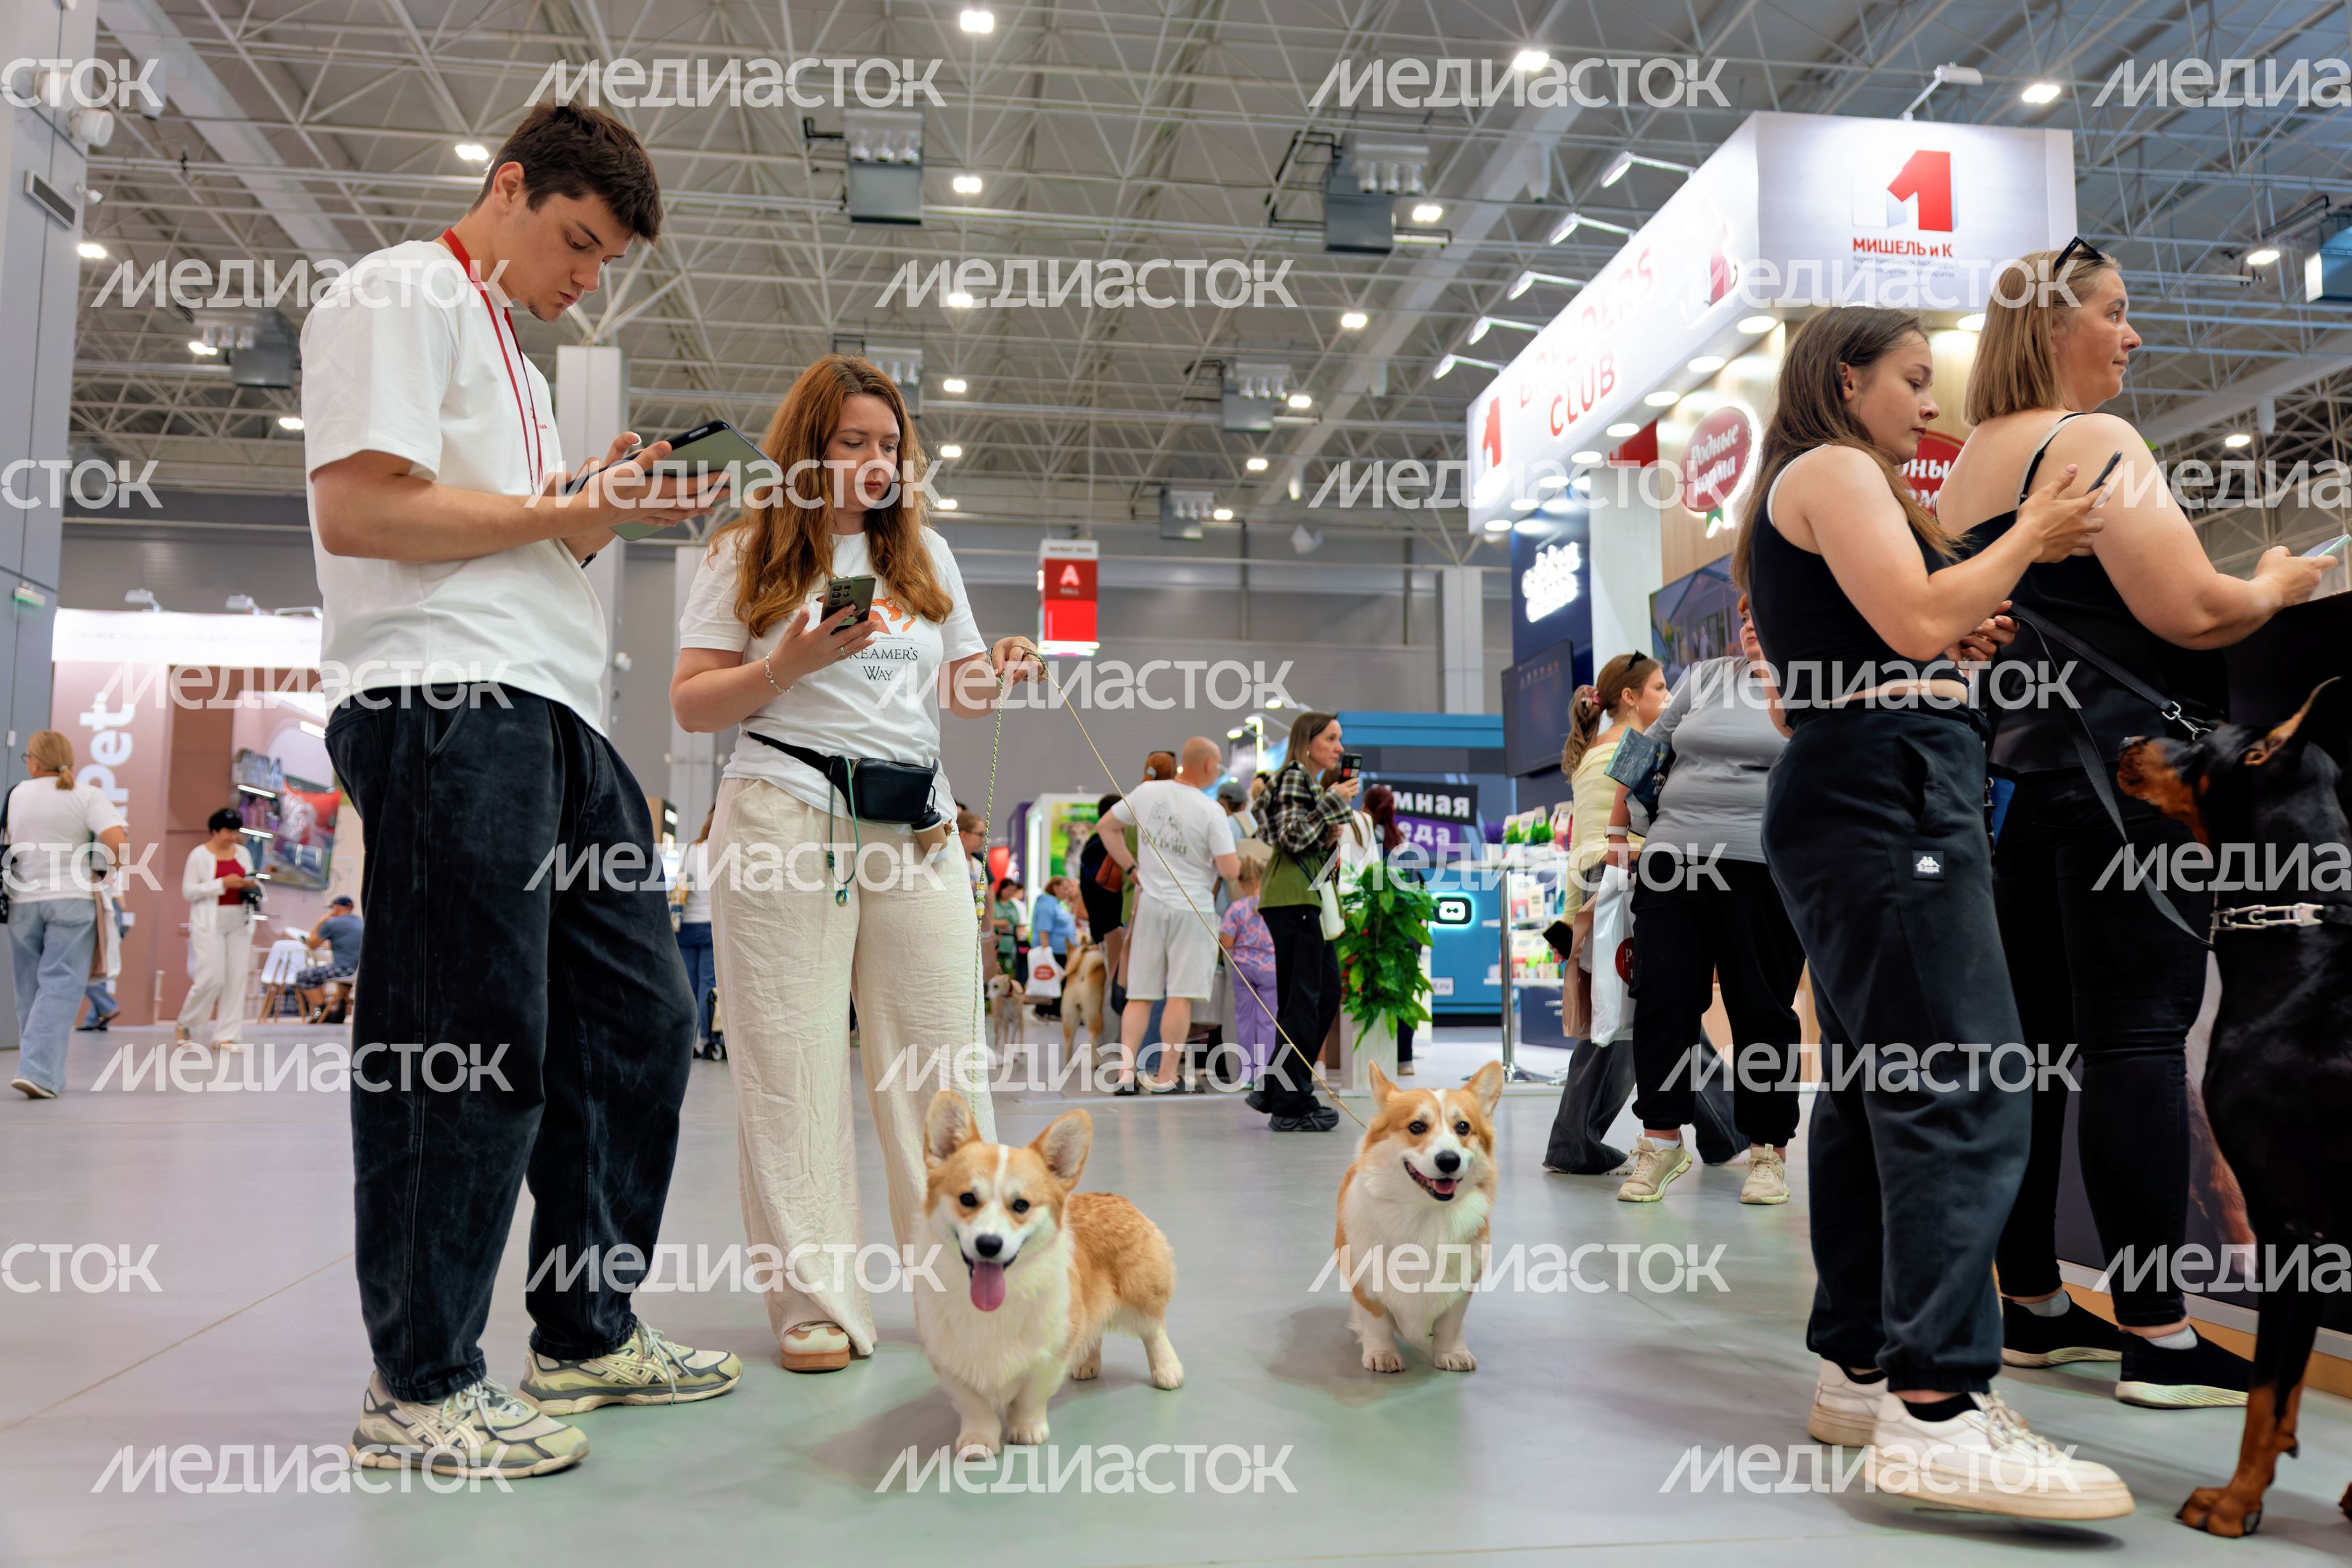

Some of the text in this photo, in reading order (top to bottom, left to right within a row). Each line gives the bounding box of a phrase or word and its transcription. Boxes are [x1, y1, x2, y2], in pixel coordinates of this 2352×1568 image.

[1853, 237, 1927, 256] МИШЕЛЬ
[1930, 245, 1939, 257] и
[1550, 350, 1616, 437] CLUB
[1690, 423, 1740, 472] Родные
[1694, 455, 1736, 498] корма
[849, 646, 918, 661] REAMER'S
[1372, 783, 1470, 818] мная
